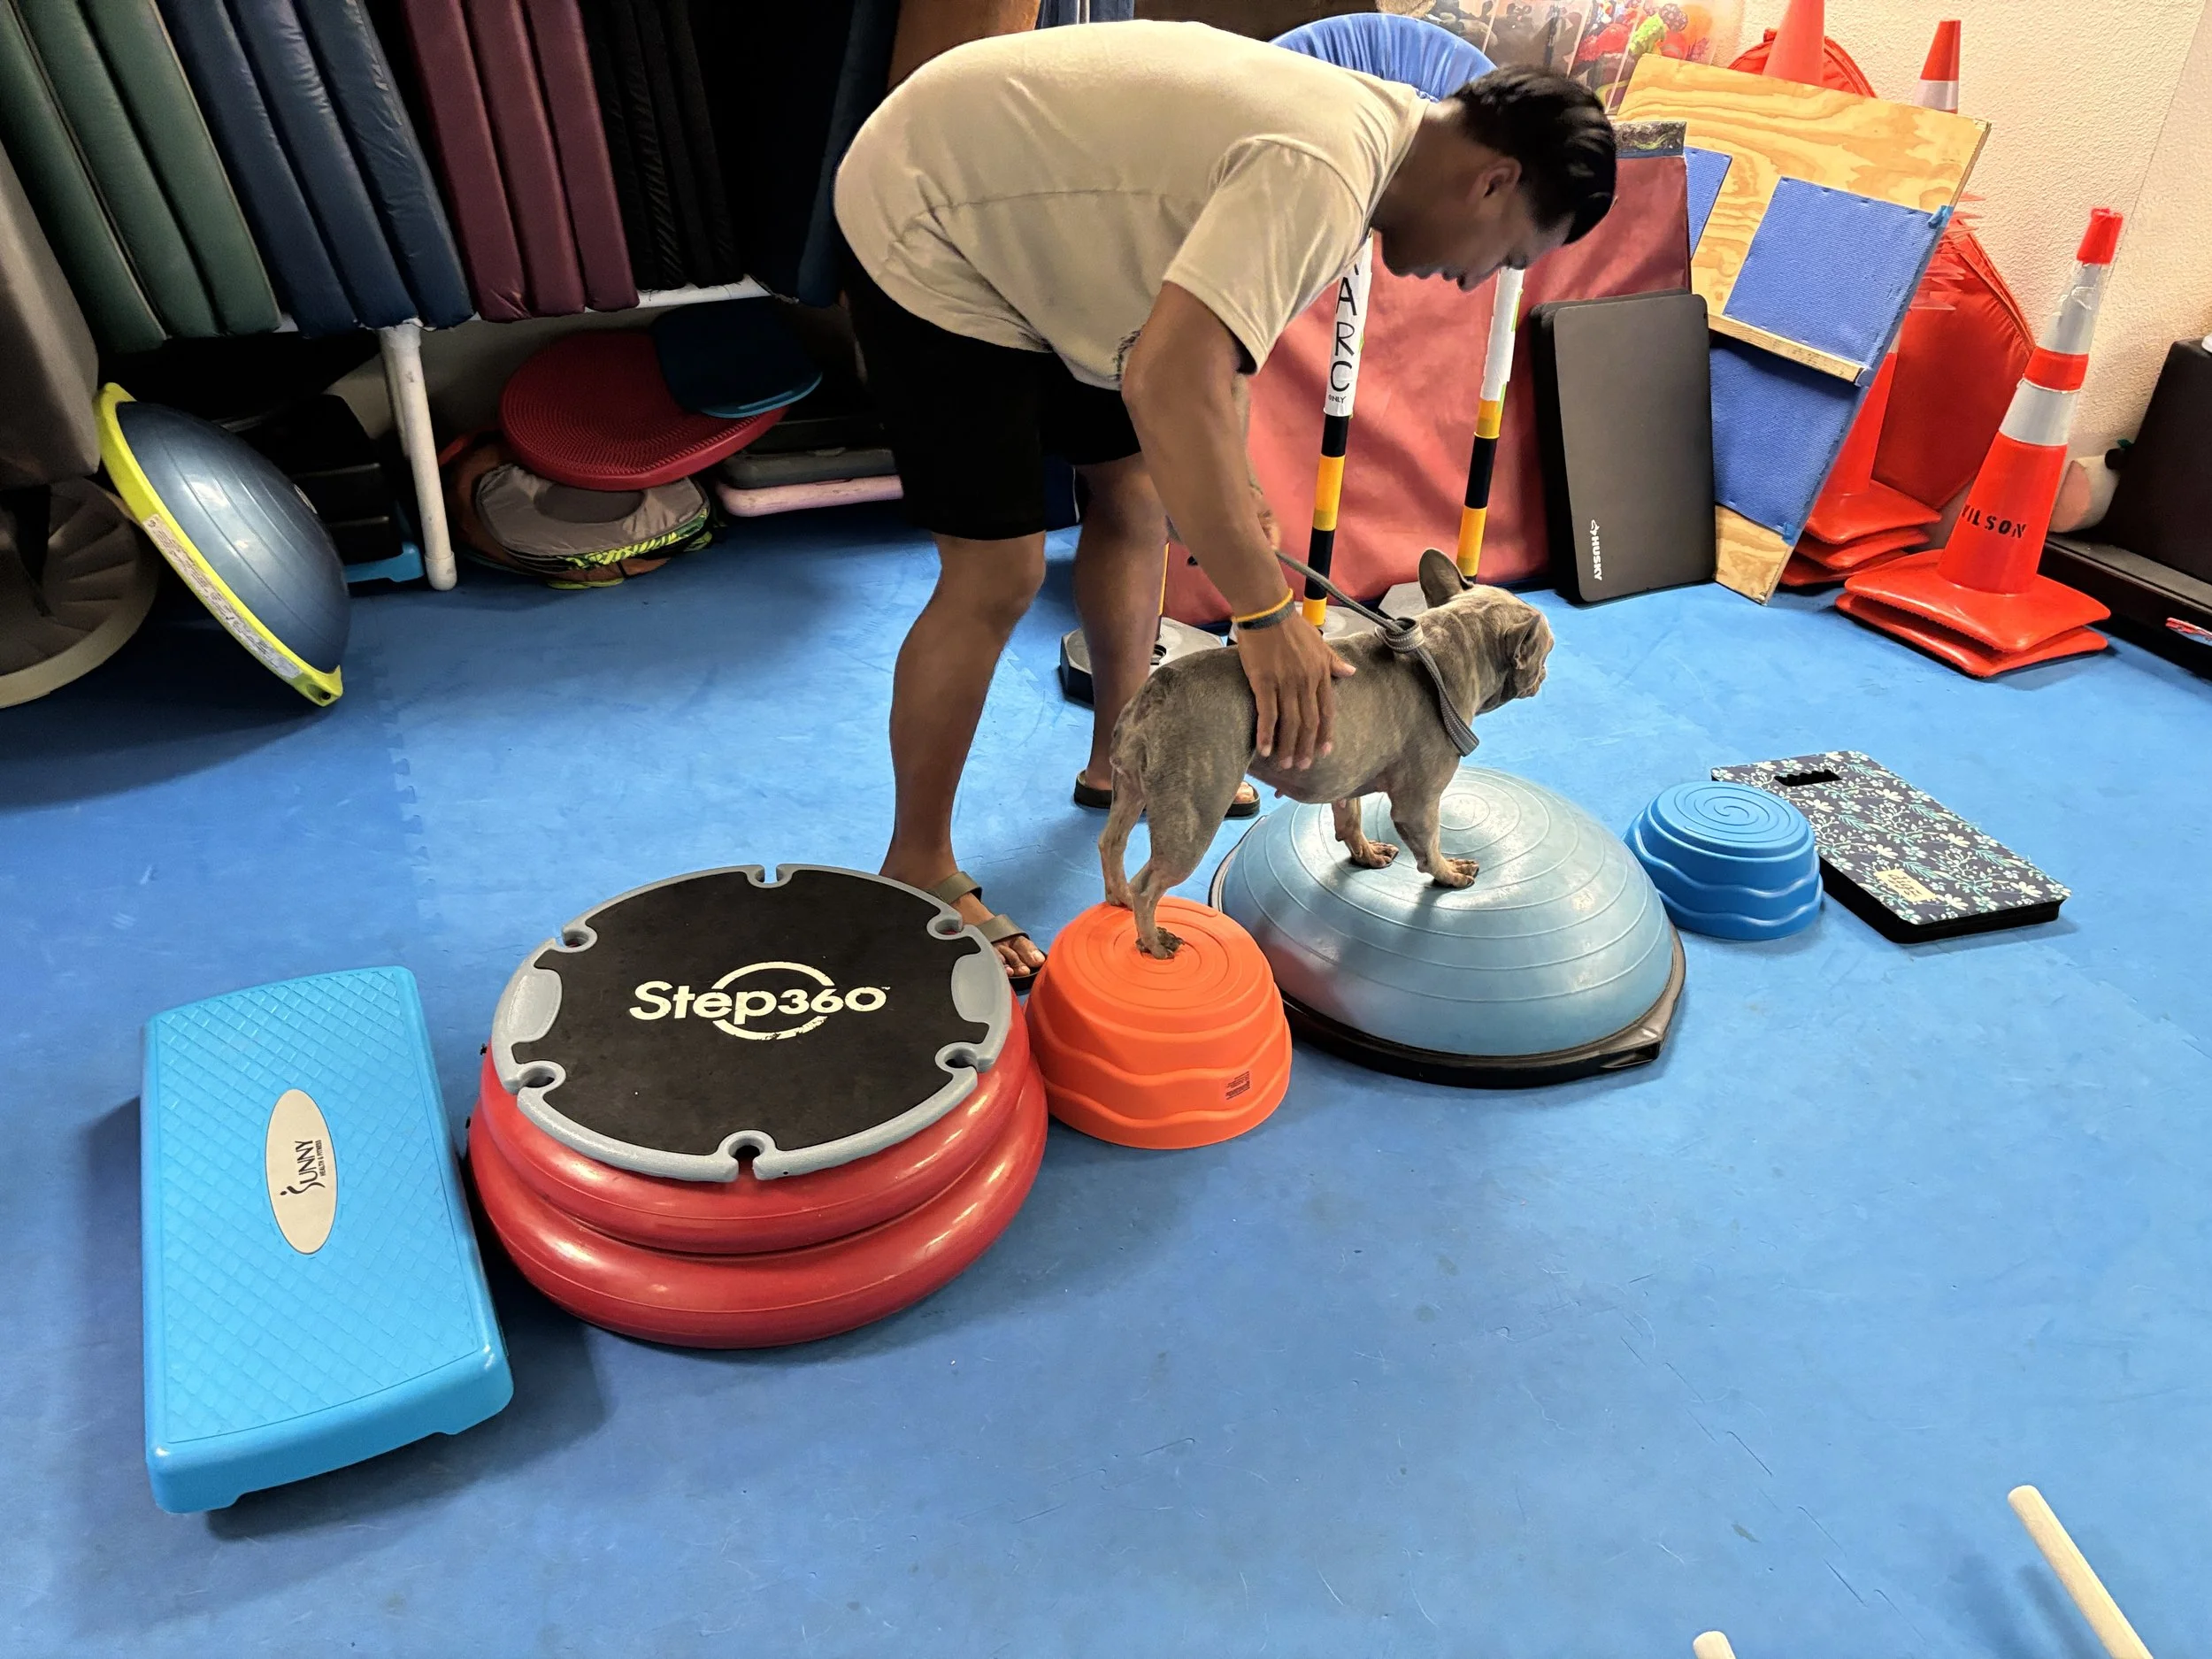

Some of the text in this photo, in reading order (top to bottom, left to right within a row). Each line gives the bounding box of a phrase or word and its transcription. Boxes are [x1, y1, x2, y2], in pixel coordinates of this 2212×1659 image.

[1330, 264, 1360, 392] ARC
[1328, 394, 1347, 404] ONLY
[1591, 535, 1602, 581] HUSKY
[629, 980, 887, 1025] Step360
[280, 1141, 326, 1195] SUNNY
[318, 1160, 326, 1177] HEALTH
